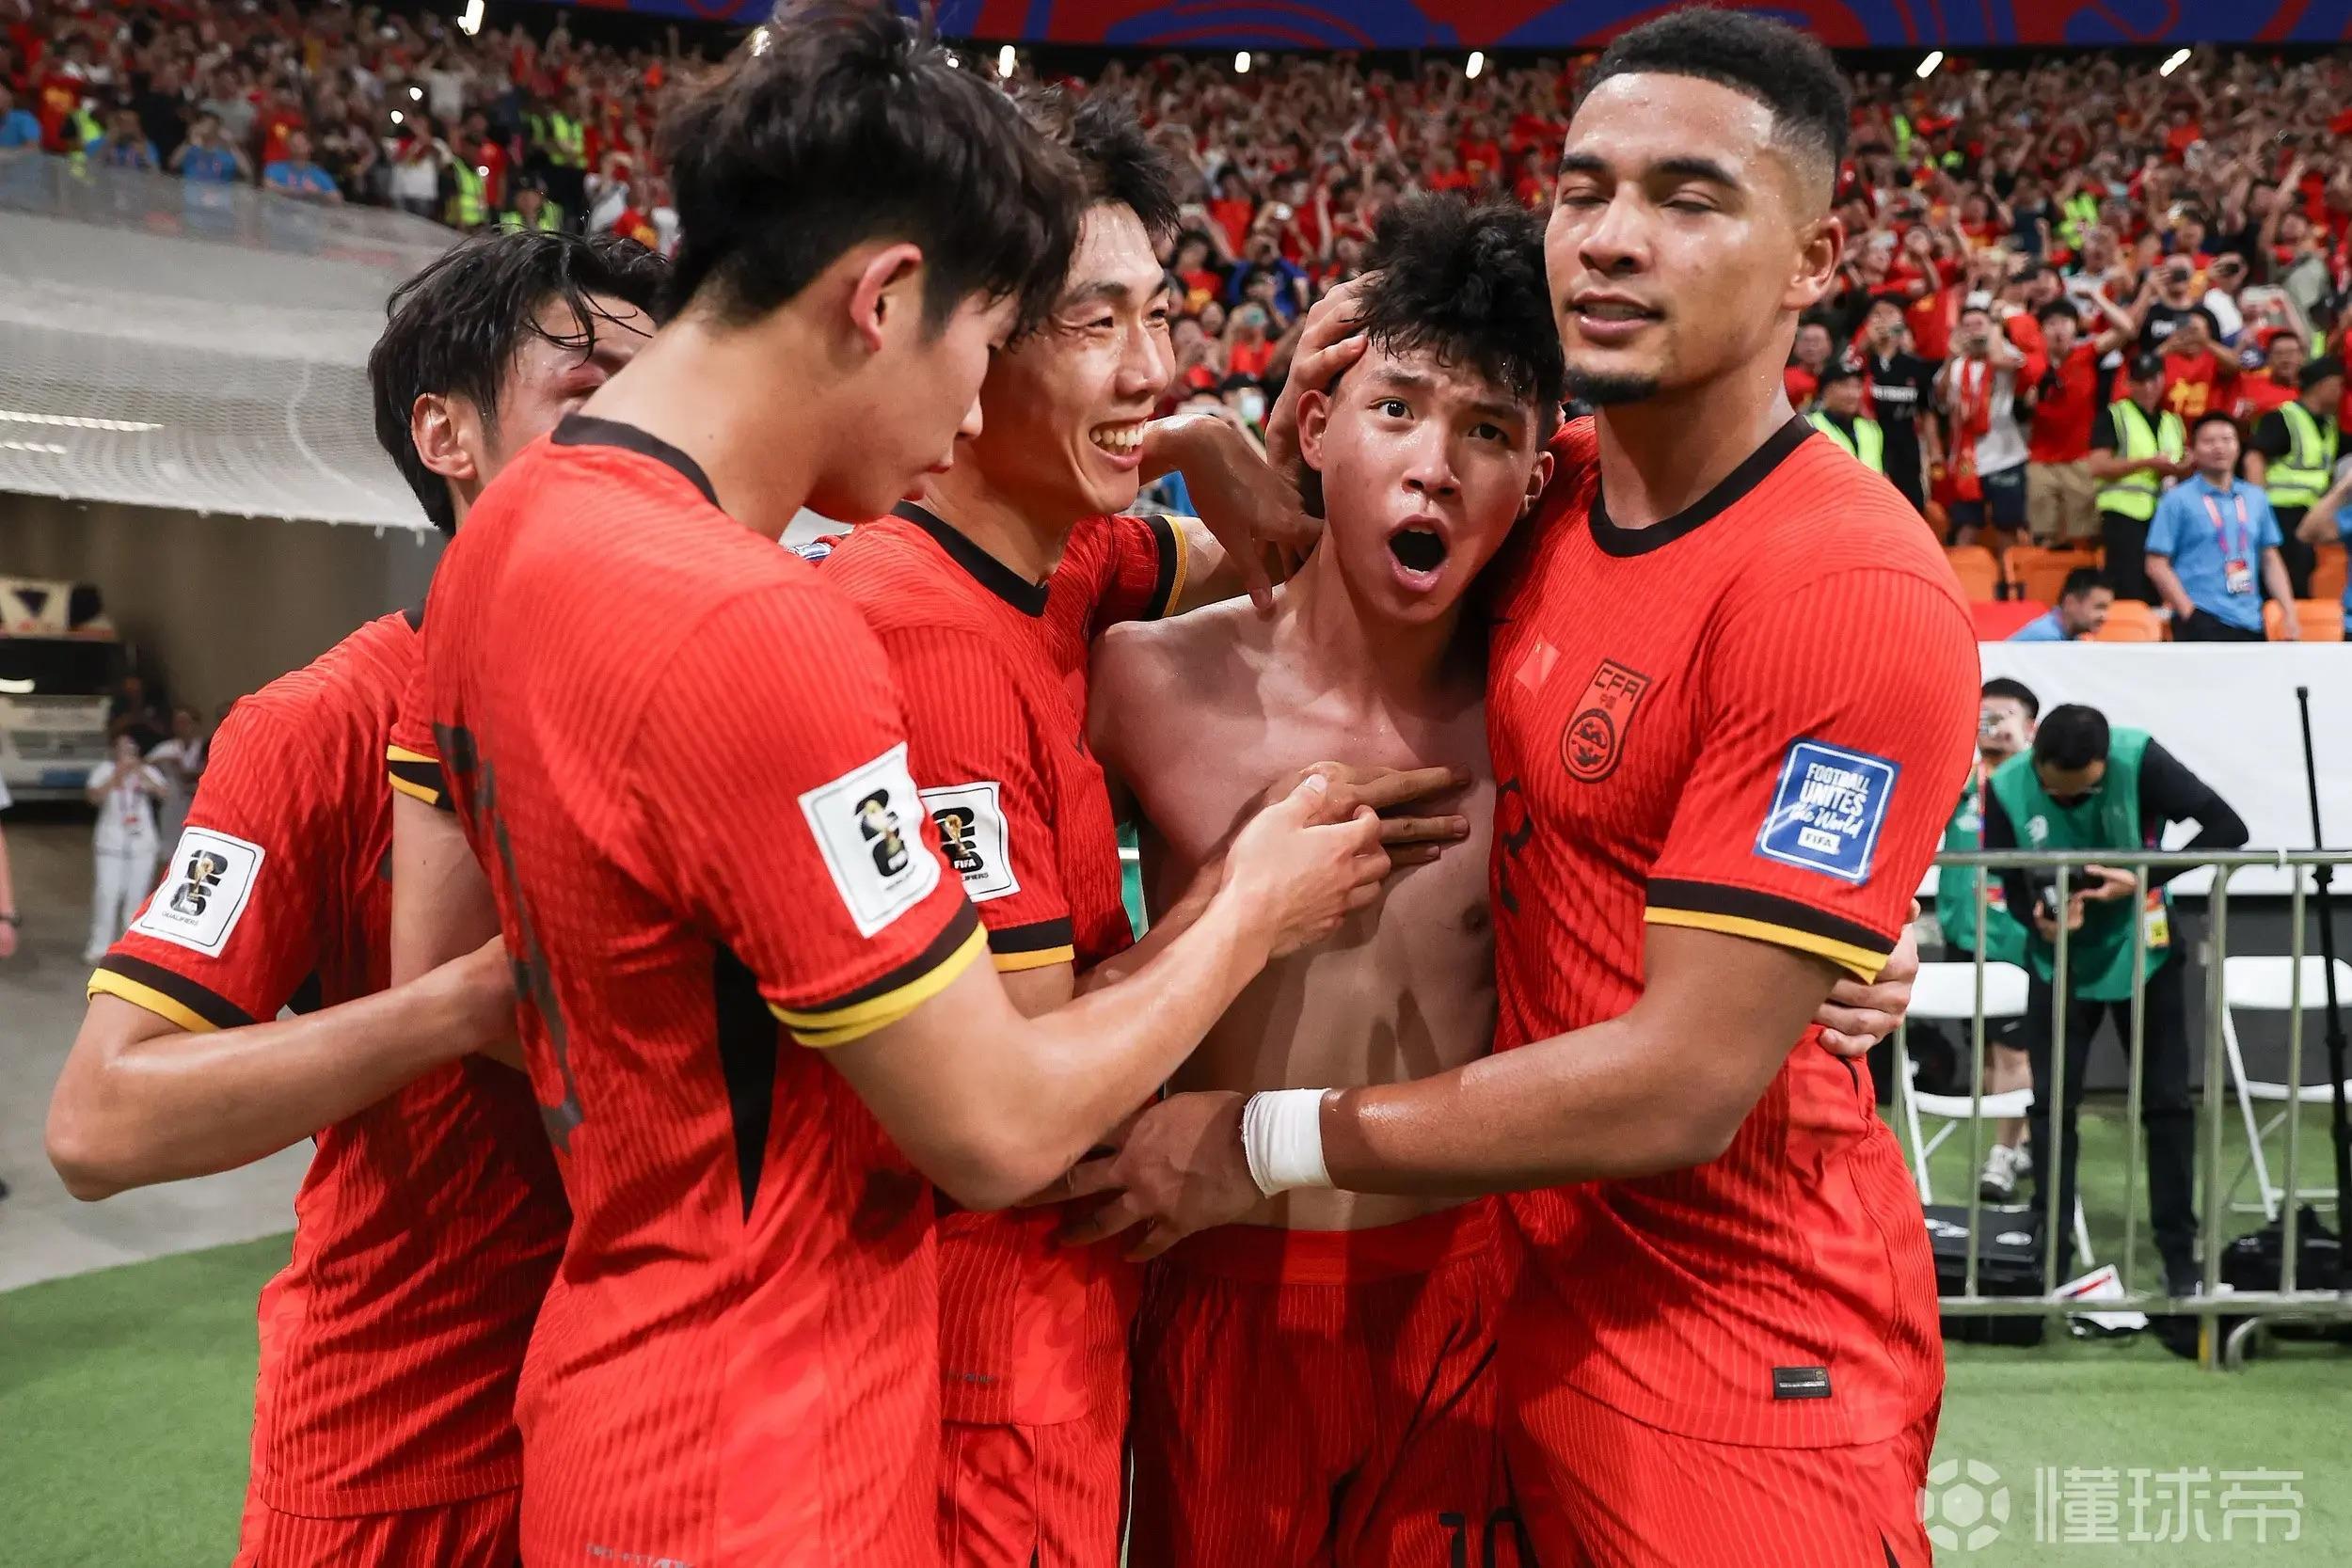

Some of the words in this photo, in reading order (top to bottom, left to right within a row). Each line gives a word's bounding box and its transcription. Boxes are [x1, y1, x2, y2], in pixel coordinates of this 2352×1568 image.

[1595, 668, 1641, 703] CFA
[1805, 762, 1871, 795] FOOTBALL
[1799, 779, 1868, 816] UNITES
[1804, 832, 1833, 847] FIFA
[953, 858, 977, 870] FIFA
